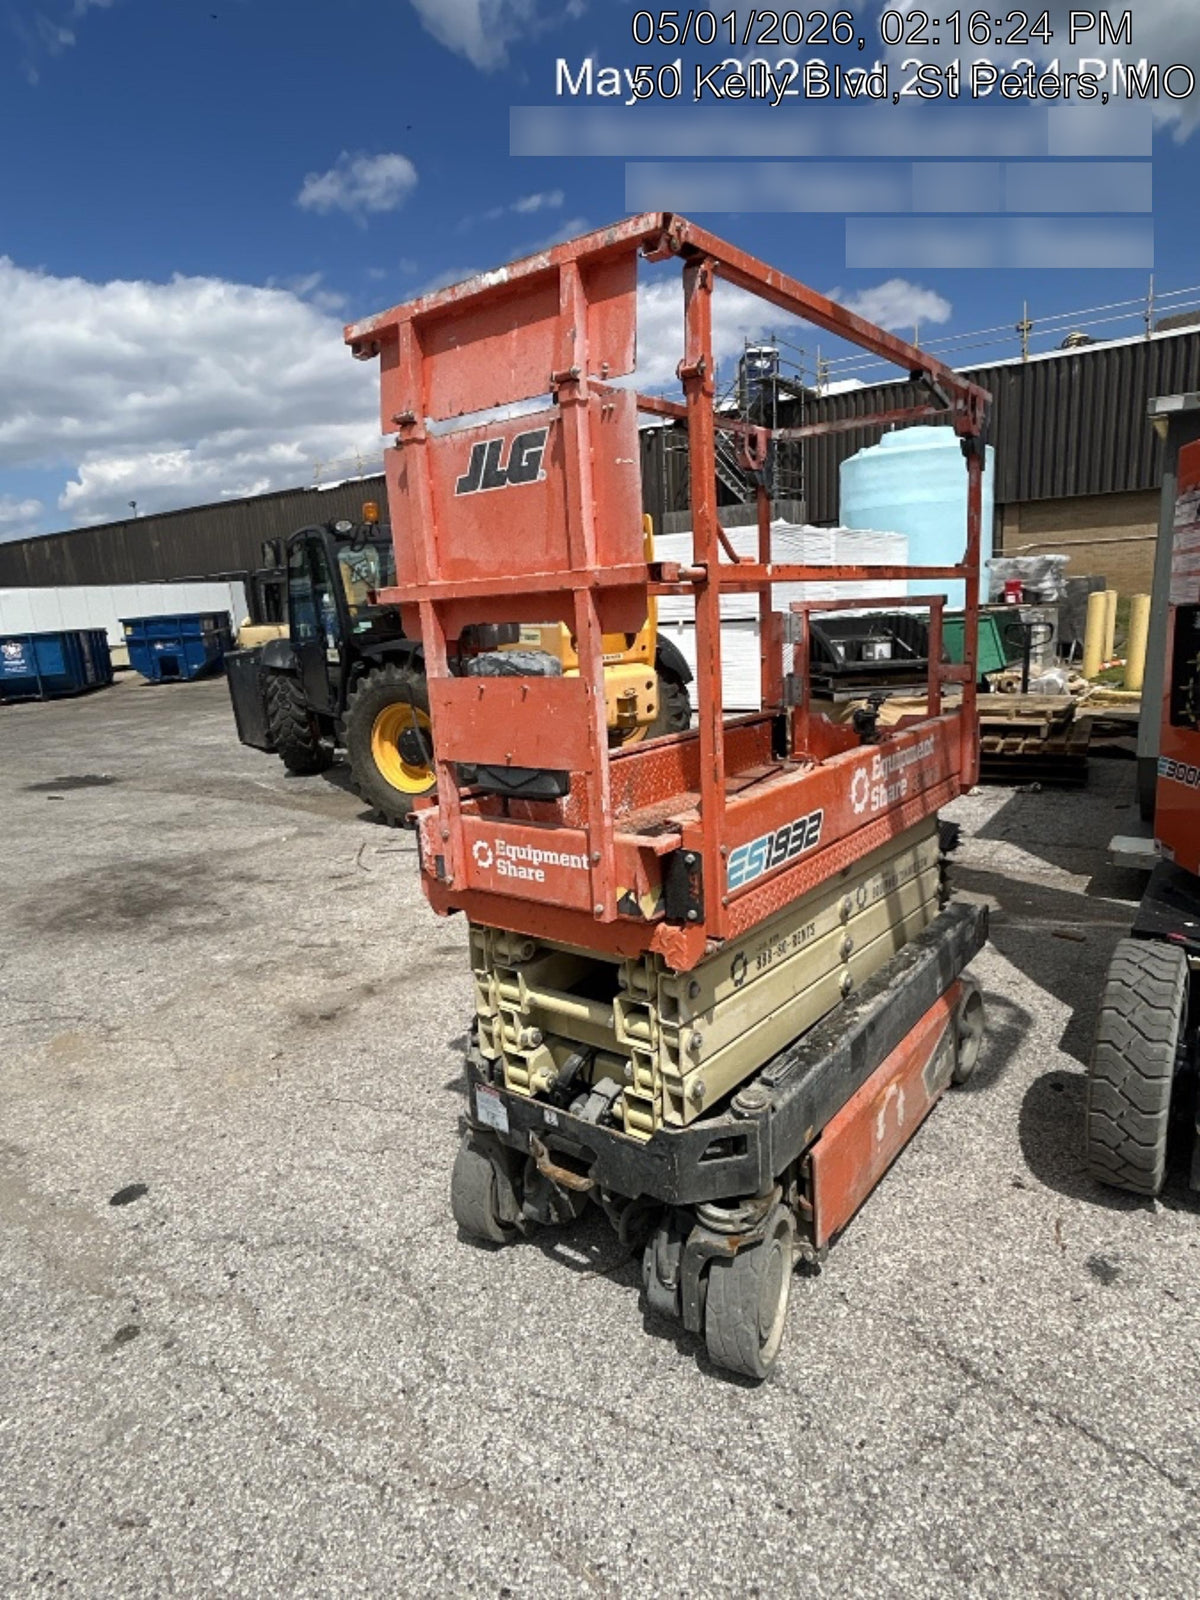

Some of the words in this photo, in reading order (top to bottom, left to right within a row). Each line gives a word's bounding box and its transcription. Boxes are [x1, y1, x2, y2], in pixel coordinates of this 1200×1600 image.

[454, 426, 550, 496] JLG
[870, 778, 909, 813] Share
[494, 838, 590, 870] Equipment
[727, 808, 824, 893] ES1932
[496, 858, 546, 883] Share
